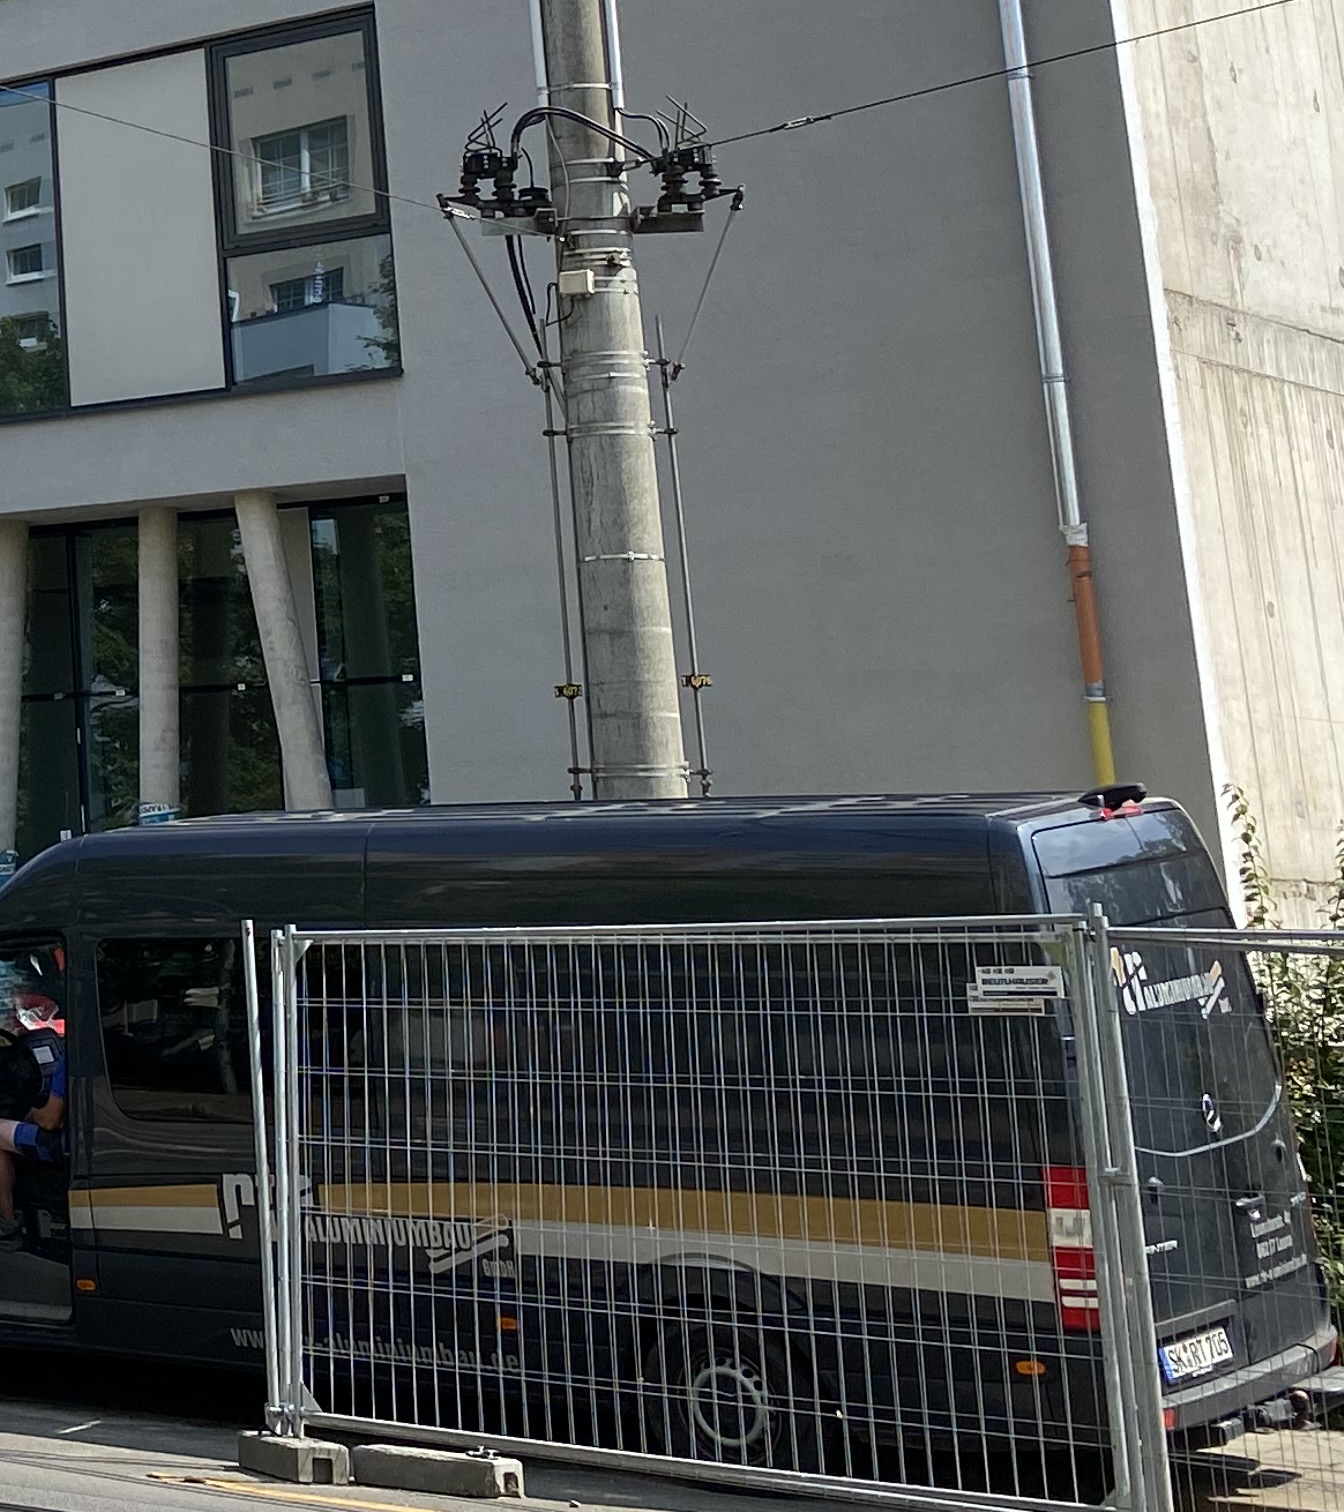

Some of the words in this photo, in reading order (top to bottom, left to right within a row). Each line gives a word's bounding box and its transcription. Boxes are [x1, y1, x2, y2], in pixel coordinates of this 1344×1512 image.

[303, 1216, 474, 1251] ALUMINIUMBAU
[1167, 1346, 1188, 1374] SK
[1188, 1338, 1208, 1366] RT
[1204, 1331, 1229, 1360] 705
